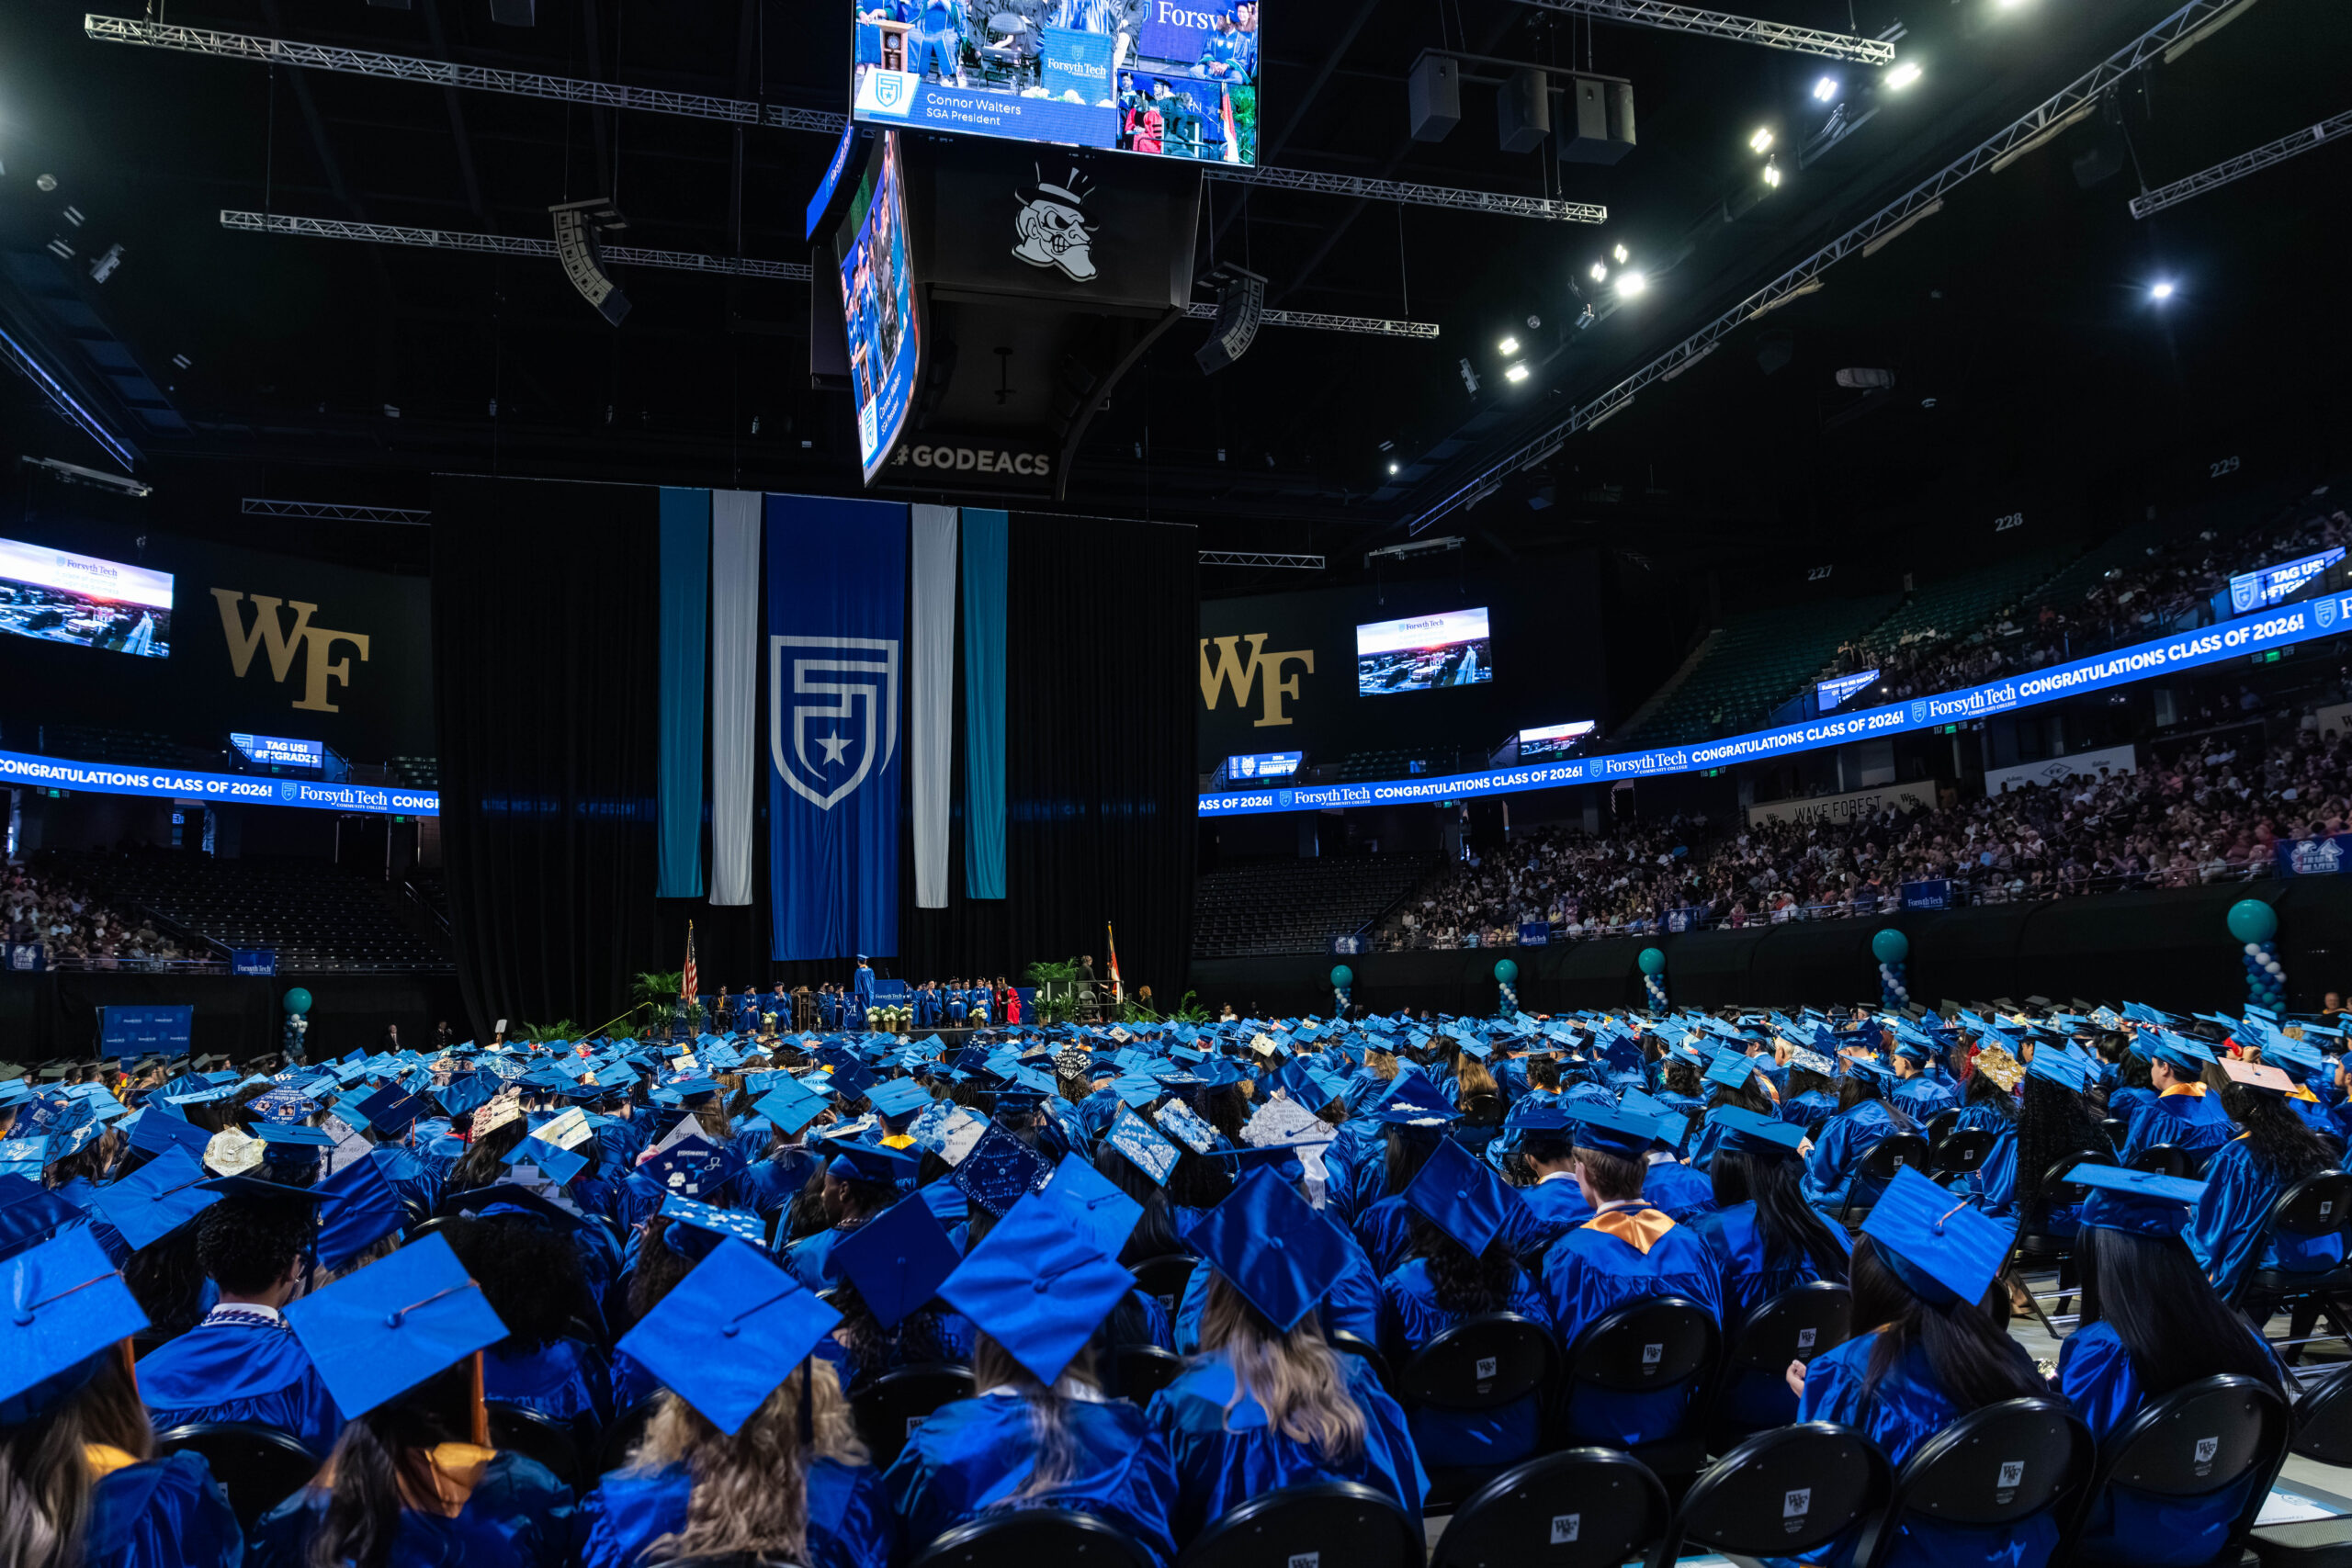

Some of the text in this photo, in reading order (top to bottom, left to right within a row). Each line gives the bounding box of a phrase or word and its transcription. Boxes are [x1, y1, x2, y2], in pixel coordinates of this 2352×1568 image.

[1047, 58, 1106, 76] Forsyth Tech
[926, 93, 1022, 115] Connor Walters
[926, 107, 1001, 126] SGA President
[2210, 456, 2241, 479] 229
[1995, 512, 2023, 532] 228
[67, 558, 118, 577] Forsyth Tech
[1807, 564, 1833, 581] 227
[2271, 568, 2299, 583] TAG
[1406, 621, 1429, 630] Forsyth
[210, 588, 369, 713] WF
[2019, 649, 2166, 696] CONGRATULATIONS
[2168, 635, 2222, 660] CLASS
[2224, 627, 2250, 647] OF
[2253, 614, 2305, 640] 2026!
[1929, 683, 2016, 717] Forsyth Tech
[266, 740, 308, 753] TAG US!
[1691, 710, 1905, 762] CONGRATULATIONS CLASS OF 2026!
[1606, 750, 1687, 773] Forsyth Tech
[153, 776, 203, 791] CLASS
[207, 781, 228, 793] OF
[231, 783, 273, 797] 2026!
[1374, 766, 1583, 799] CONGRATULATIONS CLASS OF 2026!
[300, 785, 388, 806] Forsyth Tech
[1222, 798, 1238, 808] OF
[1240, 795, 1272, 807] 2026!
[1295, 786, 1370, 806] Forsyth Tech
[1795, 795, 1882, 822] WAKE FOREST
